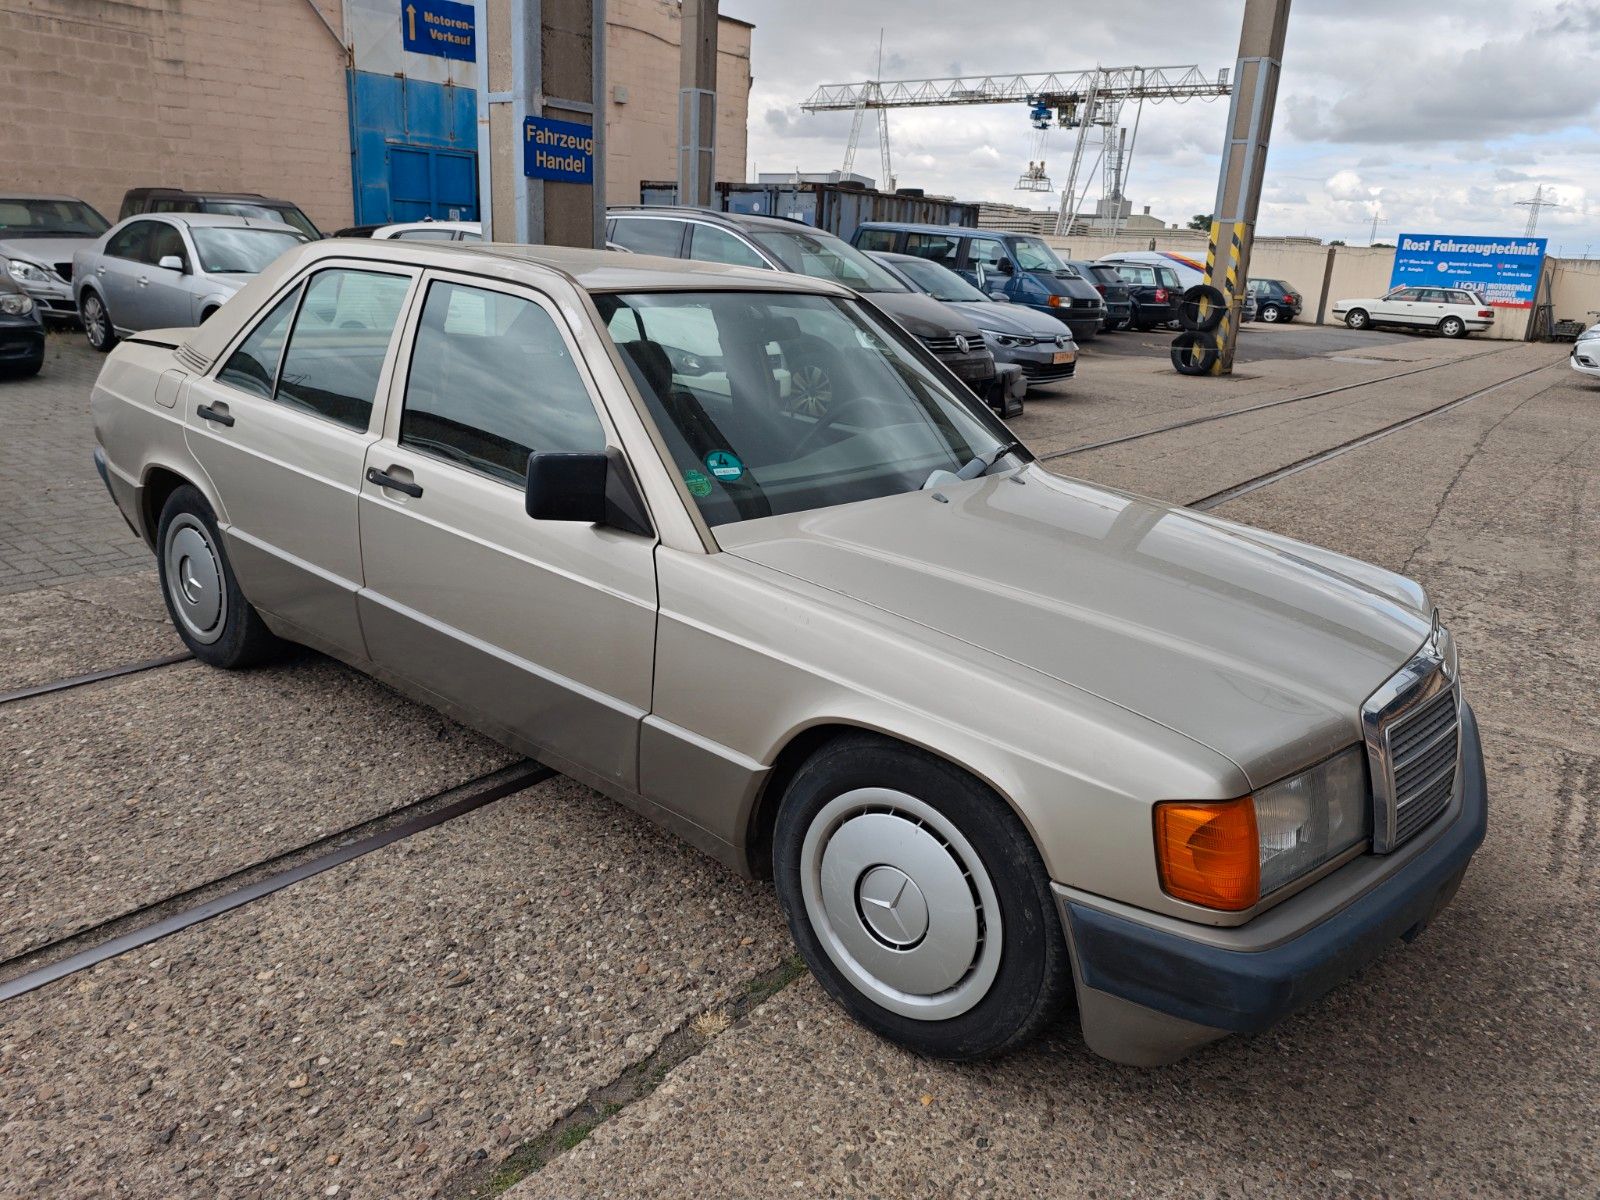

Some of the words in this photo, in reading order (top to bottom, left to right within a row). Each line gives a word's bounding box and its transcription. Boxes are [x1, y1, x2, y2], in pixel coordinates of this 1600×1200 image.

[424, 11, 474, 30] Motoren-
[430, 29, 470, 45] Verkauf
[526, 124, 593, 155] Fahrzeug
[536, 150, 585, 173] Handel
[1402, 238, 1430, 251] Rost
[1433, 240, 1539, 256] Fahrzeugtechnik
[1487, 282, 1533, 292] MOTORENÖLE
